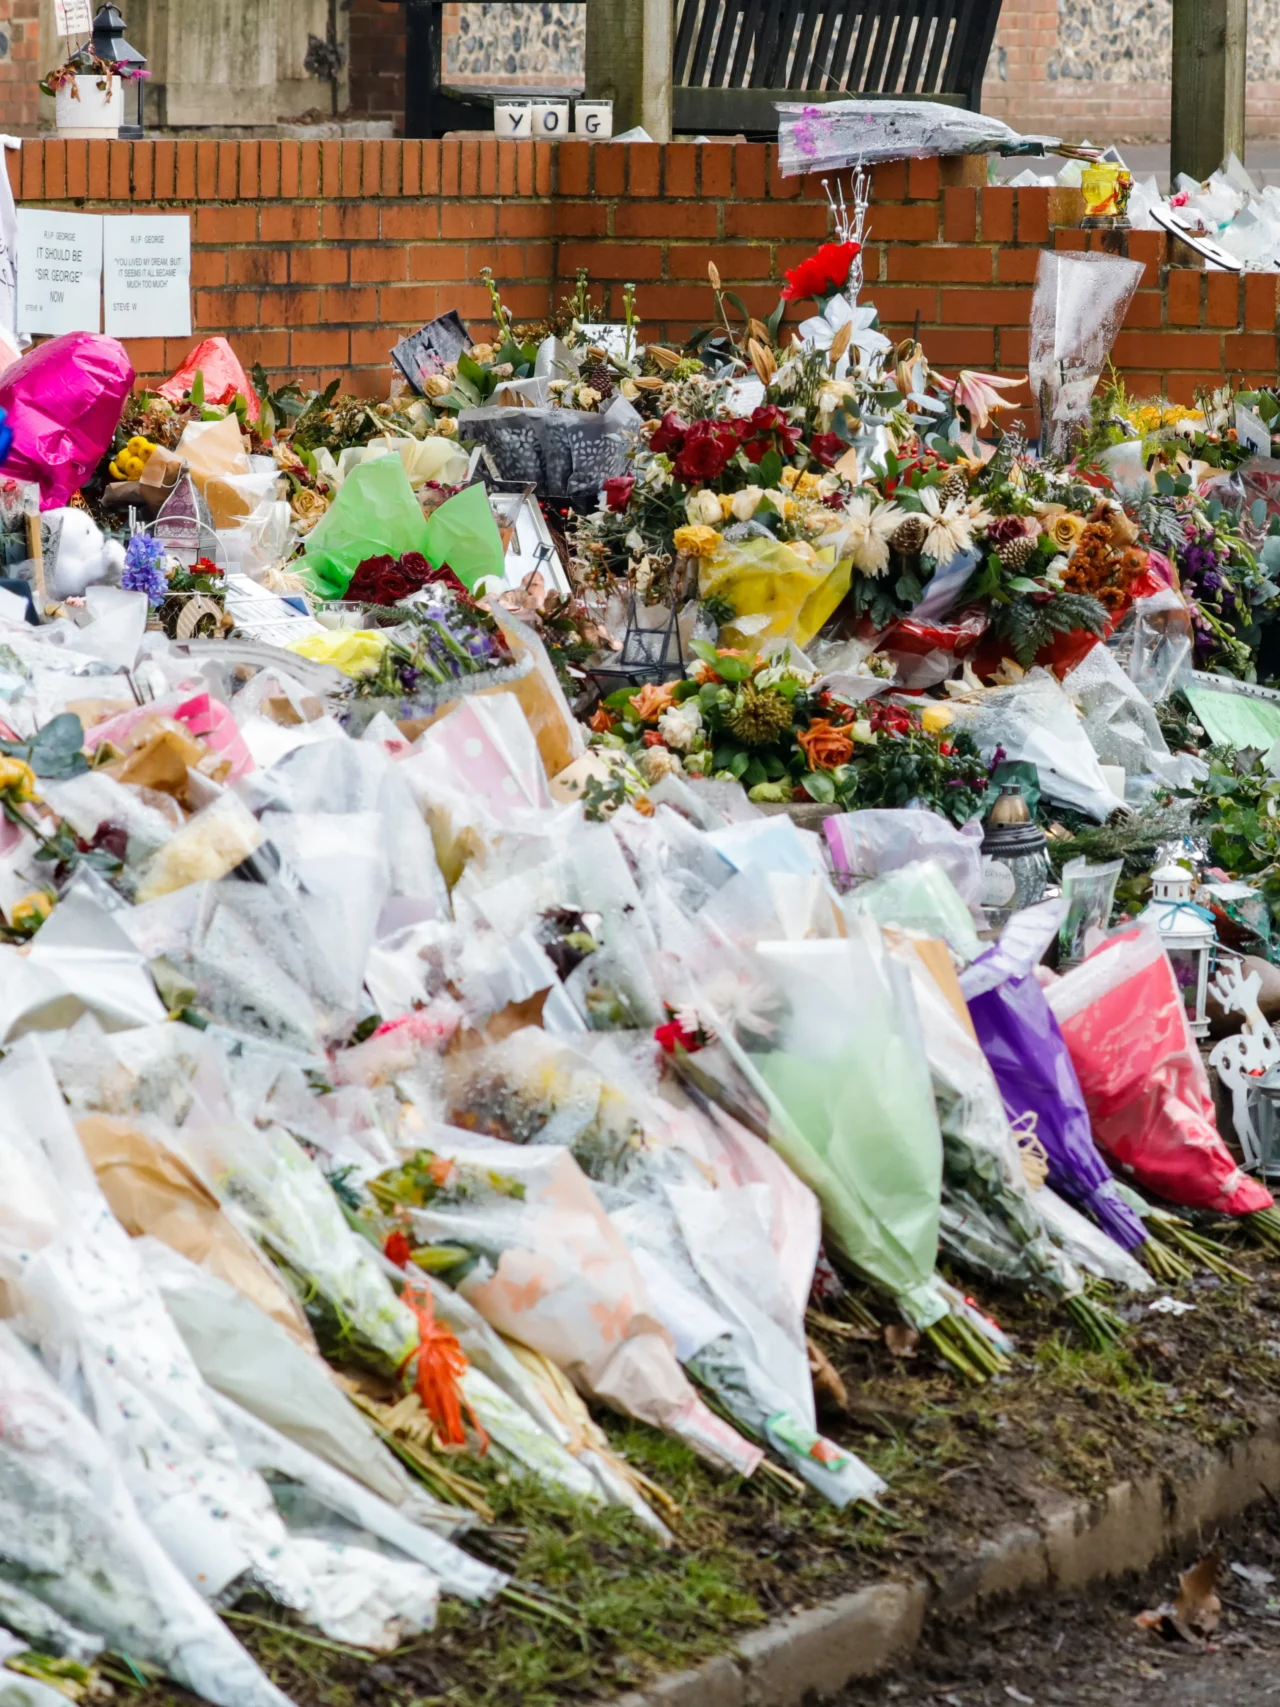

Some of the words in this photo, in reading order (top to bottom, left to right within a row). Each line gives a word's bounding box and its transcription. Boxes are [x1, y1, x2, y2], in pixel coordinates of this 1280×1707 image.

[585, 114, 601, 133] G
[56, 231, 76, 242] GEORGE
[144, 235, 165, 244] GEORGE
[36, 246, 43, 259] IT
[44, 247, 71, 261] SHOULD
[72, 249, 83, 262] BE
[143, 257, 150, 266] MY
[170, 257, 181, 266] BUT
[124, 268, 141, 278] SEEMS
[147, 268, 155, 277] ALL
[156, 268, 177, 277] BECAME
[126, 280, 142, 289] MUCH
[142, 279, 152, 288] TOO
[49, 290, 65, 303] NOW
[112, 302, 130, 312] STEVE
